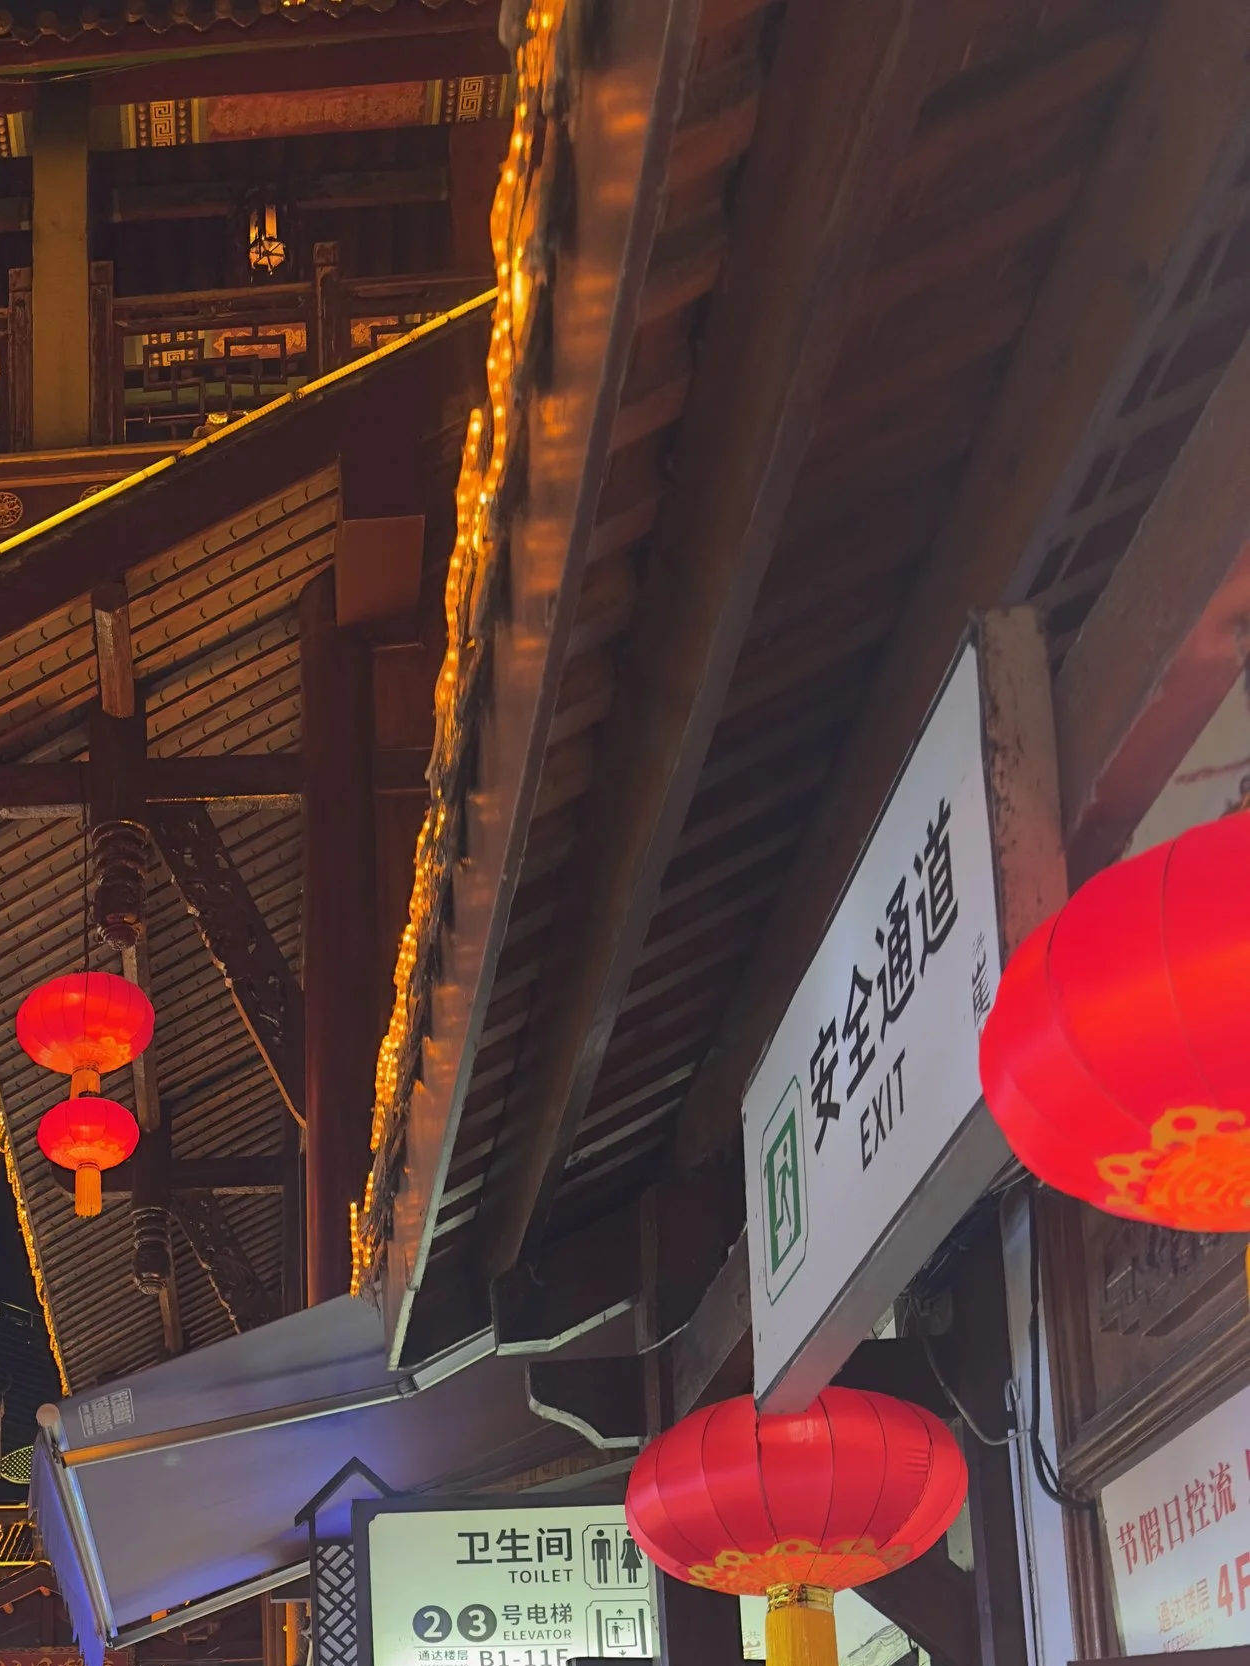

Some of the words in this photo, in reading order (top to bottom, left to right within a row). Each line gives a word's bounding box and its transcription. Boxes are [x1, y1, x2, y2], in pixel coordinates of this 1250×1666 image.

[810, 797, 959, 1155] 安全通道
[860, 1049, 906, 1172] EXIT
[1117, 1462, 1237, 1576] 节假日控流
[456, 1528, 574, 1565] 卫生间
[508, 1569, 574, 1584] TOILET
[502, 1603, 573, 1625] 号电梯
[503, 1629, 572, 1641] ELEVATOR
[418, 1650, 469, 1661] 通达楼层
[480, 1649, 568, 1666] B1-11F
